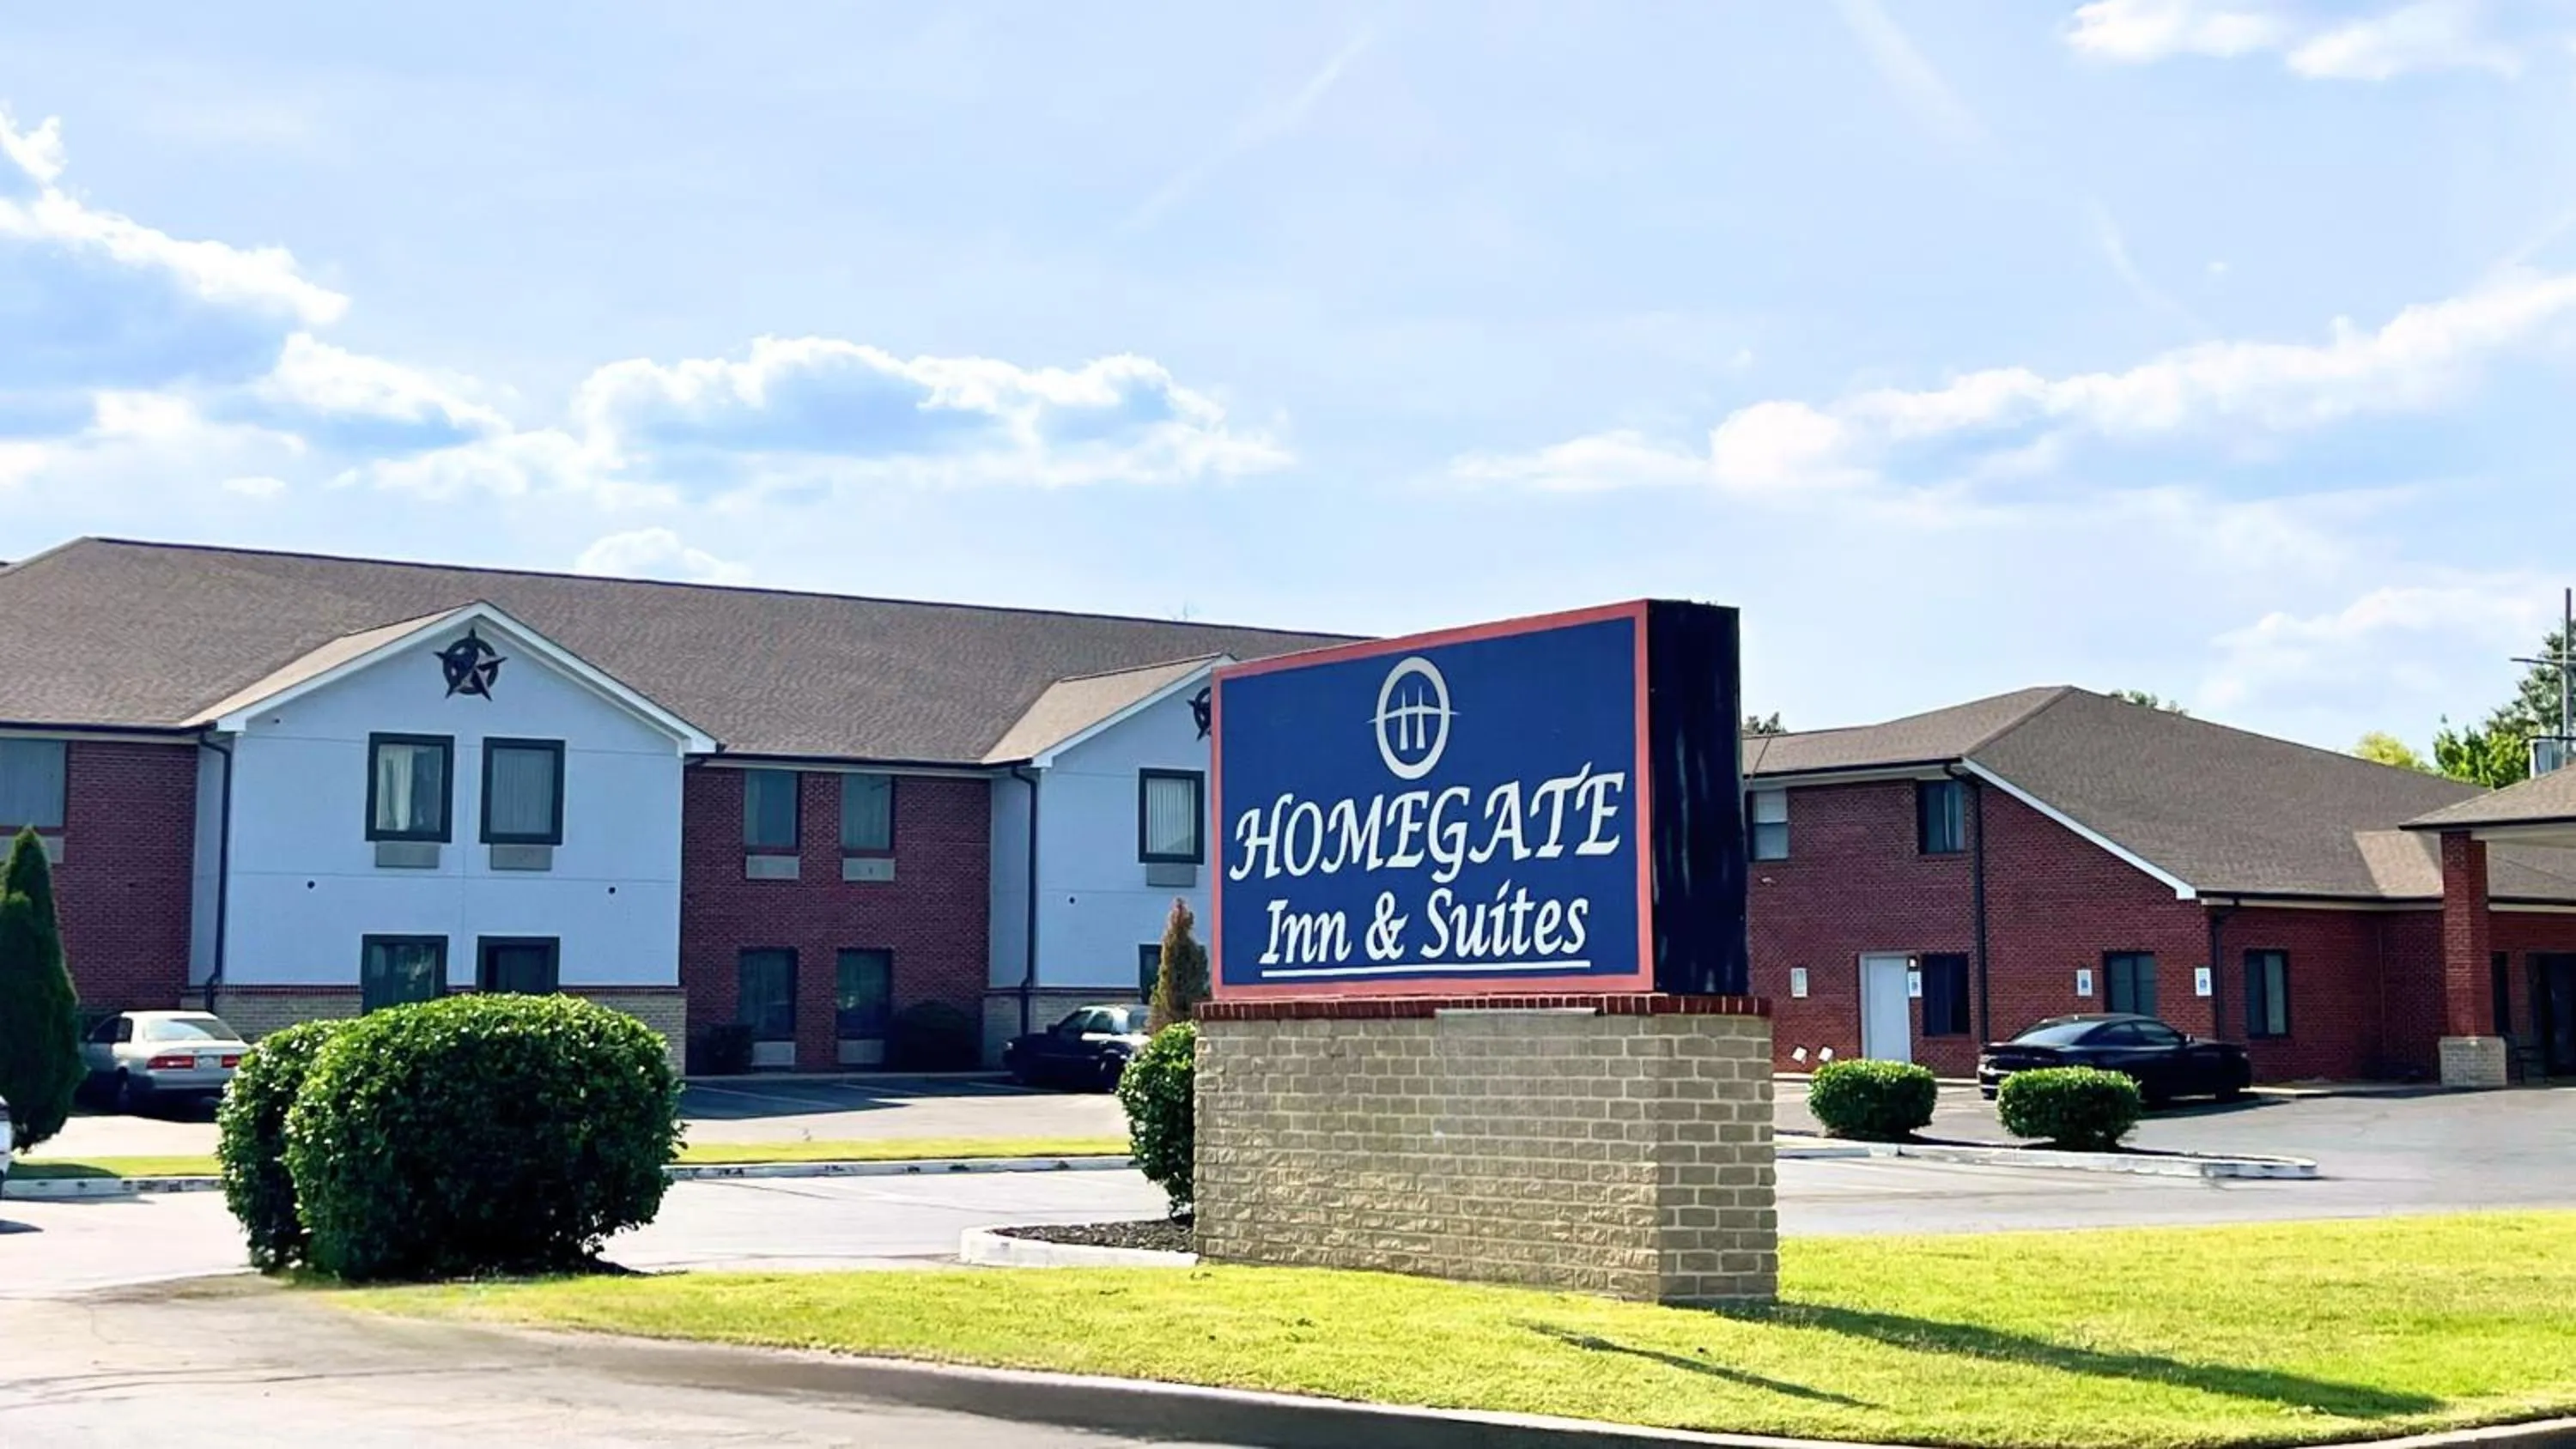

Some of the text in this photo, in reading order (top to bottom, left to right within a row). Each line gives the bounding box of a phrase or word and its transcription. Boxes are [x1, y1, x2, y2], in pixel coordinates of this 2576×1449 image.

[1229, 761, 1625, 883] HOMEGATE
[1259, 879, 1589, 964] Inn & Suites
